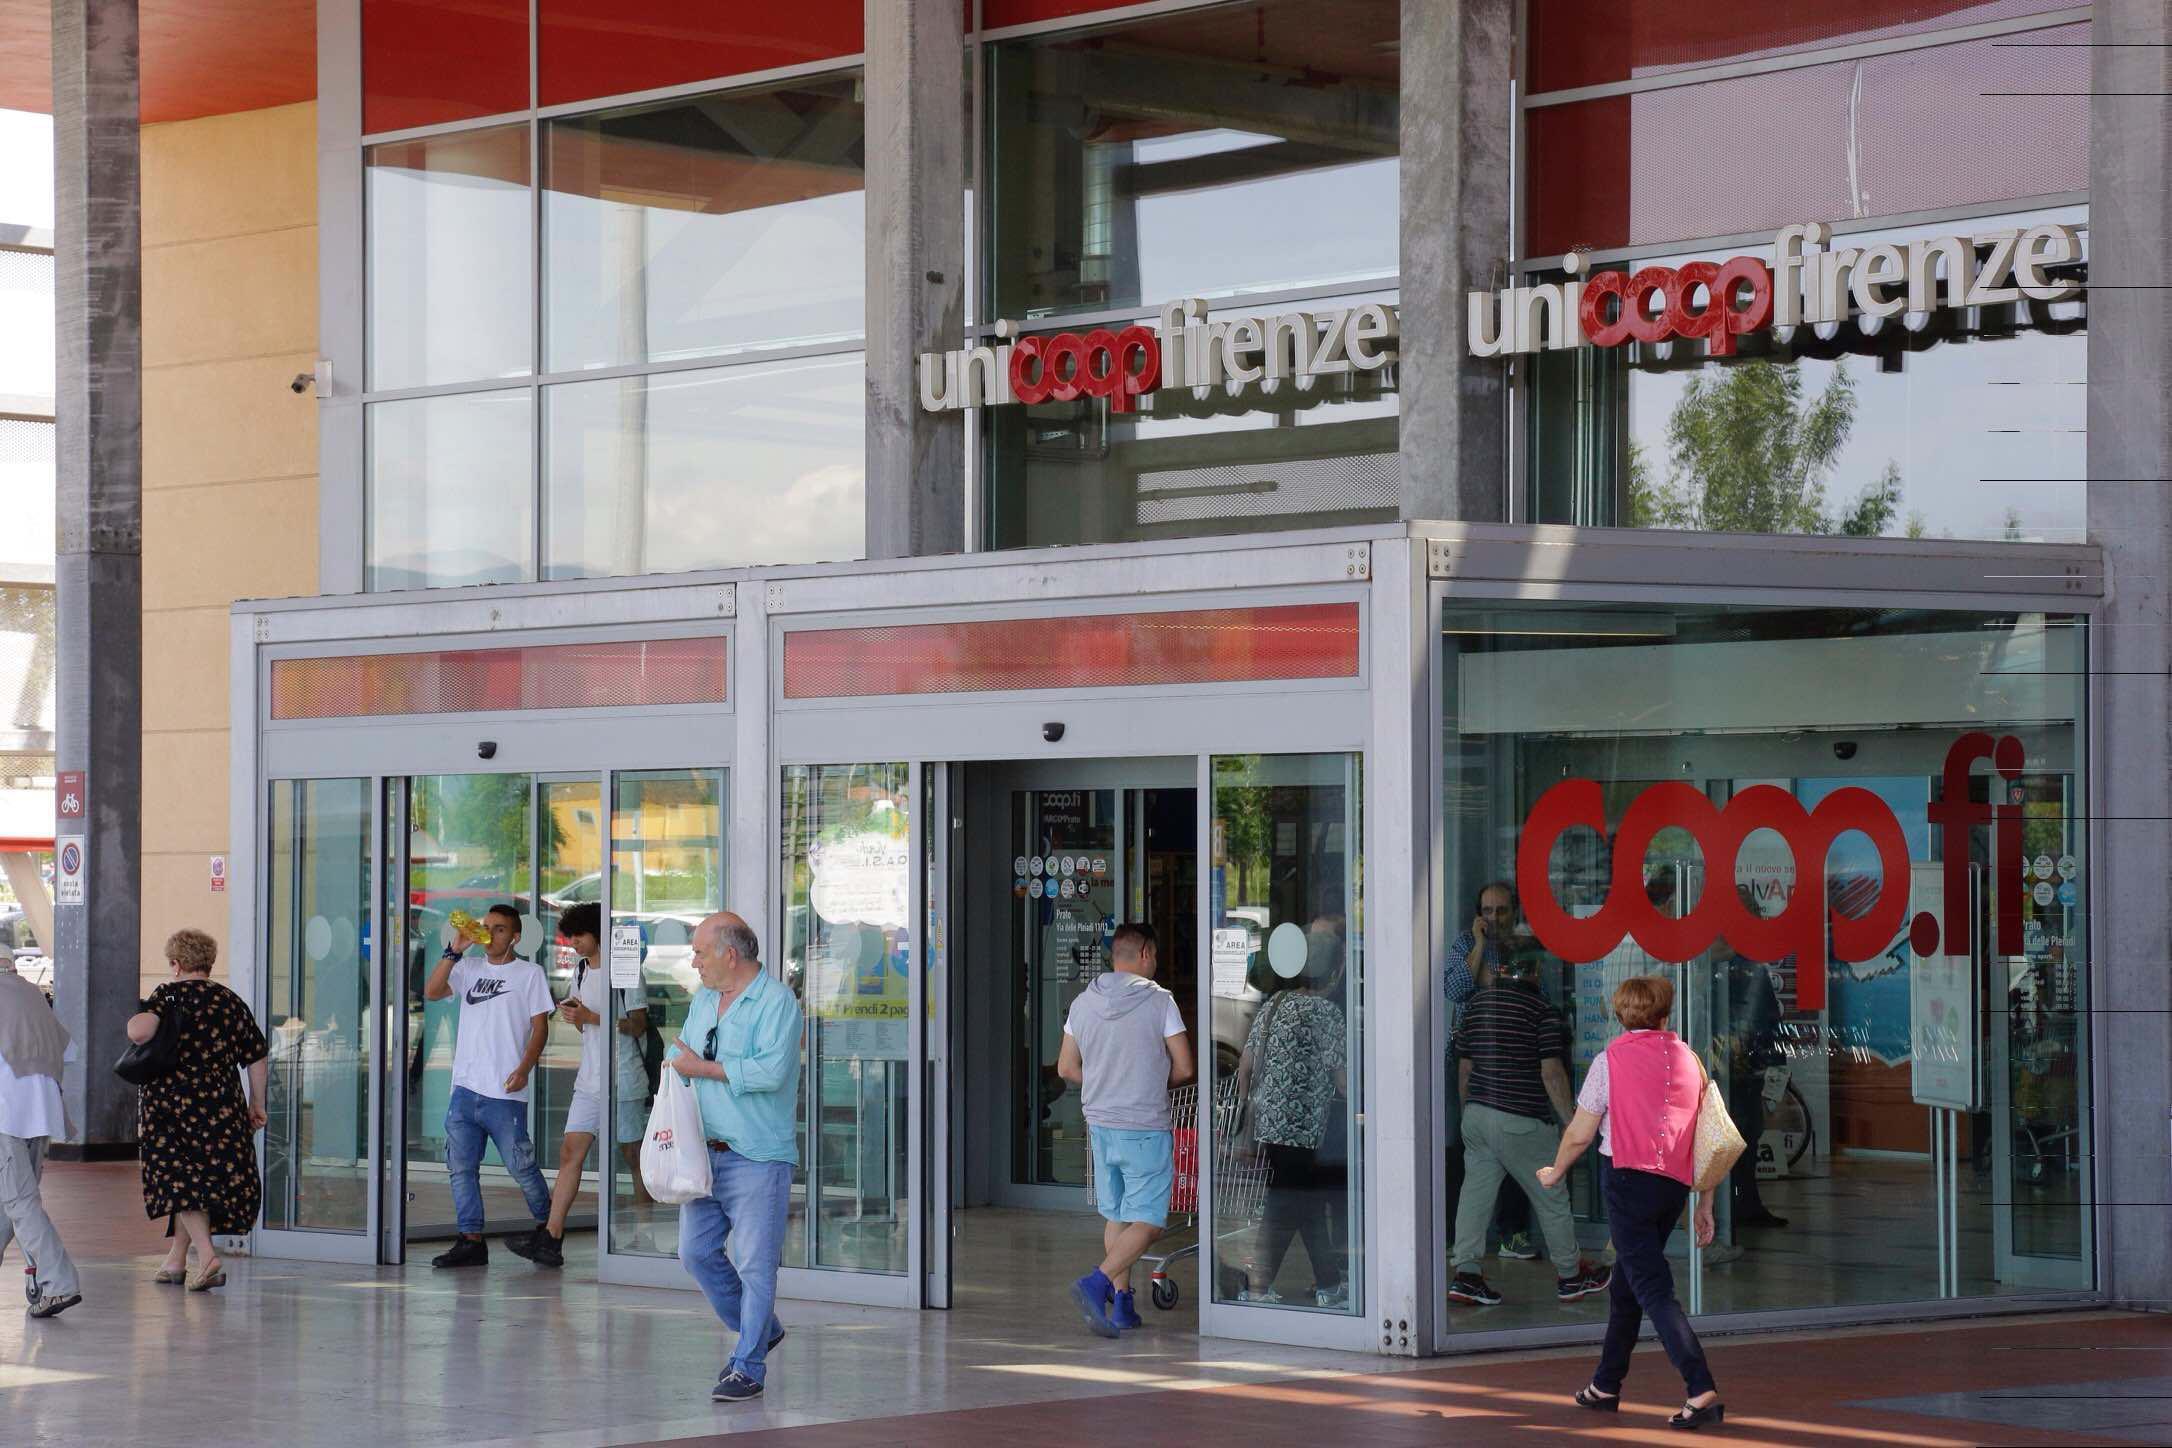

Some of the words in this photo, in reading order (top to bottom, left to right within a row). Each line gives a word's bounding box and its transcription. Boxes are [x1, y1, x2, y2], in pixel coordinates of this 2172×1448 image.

[1517, 731, 2025, 1011] coop.fi
[623, 938, 638, 946] AREA
[1226, 941, 1246, 949] AREA
[472, 977, 507, 994] NIKE
